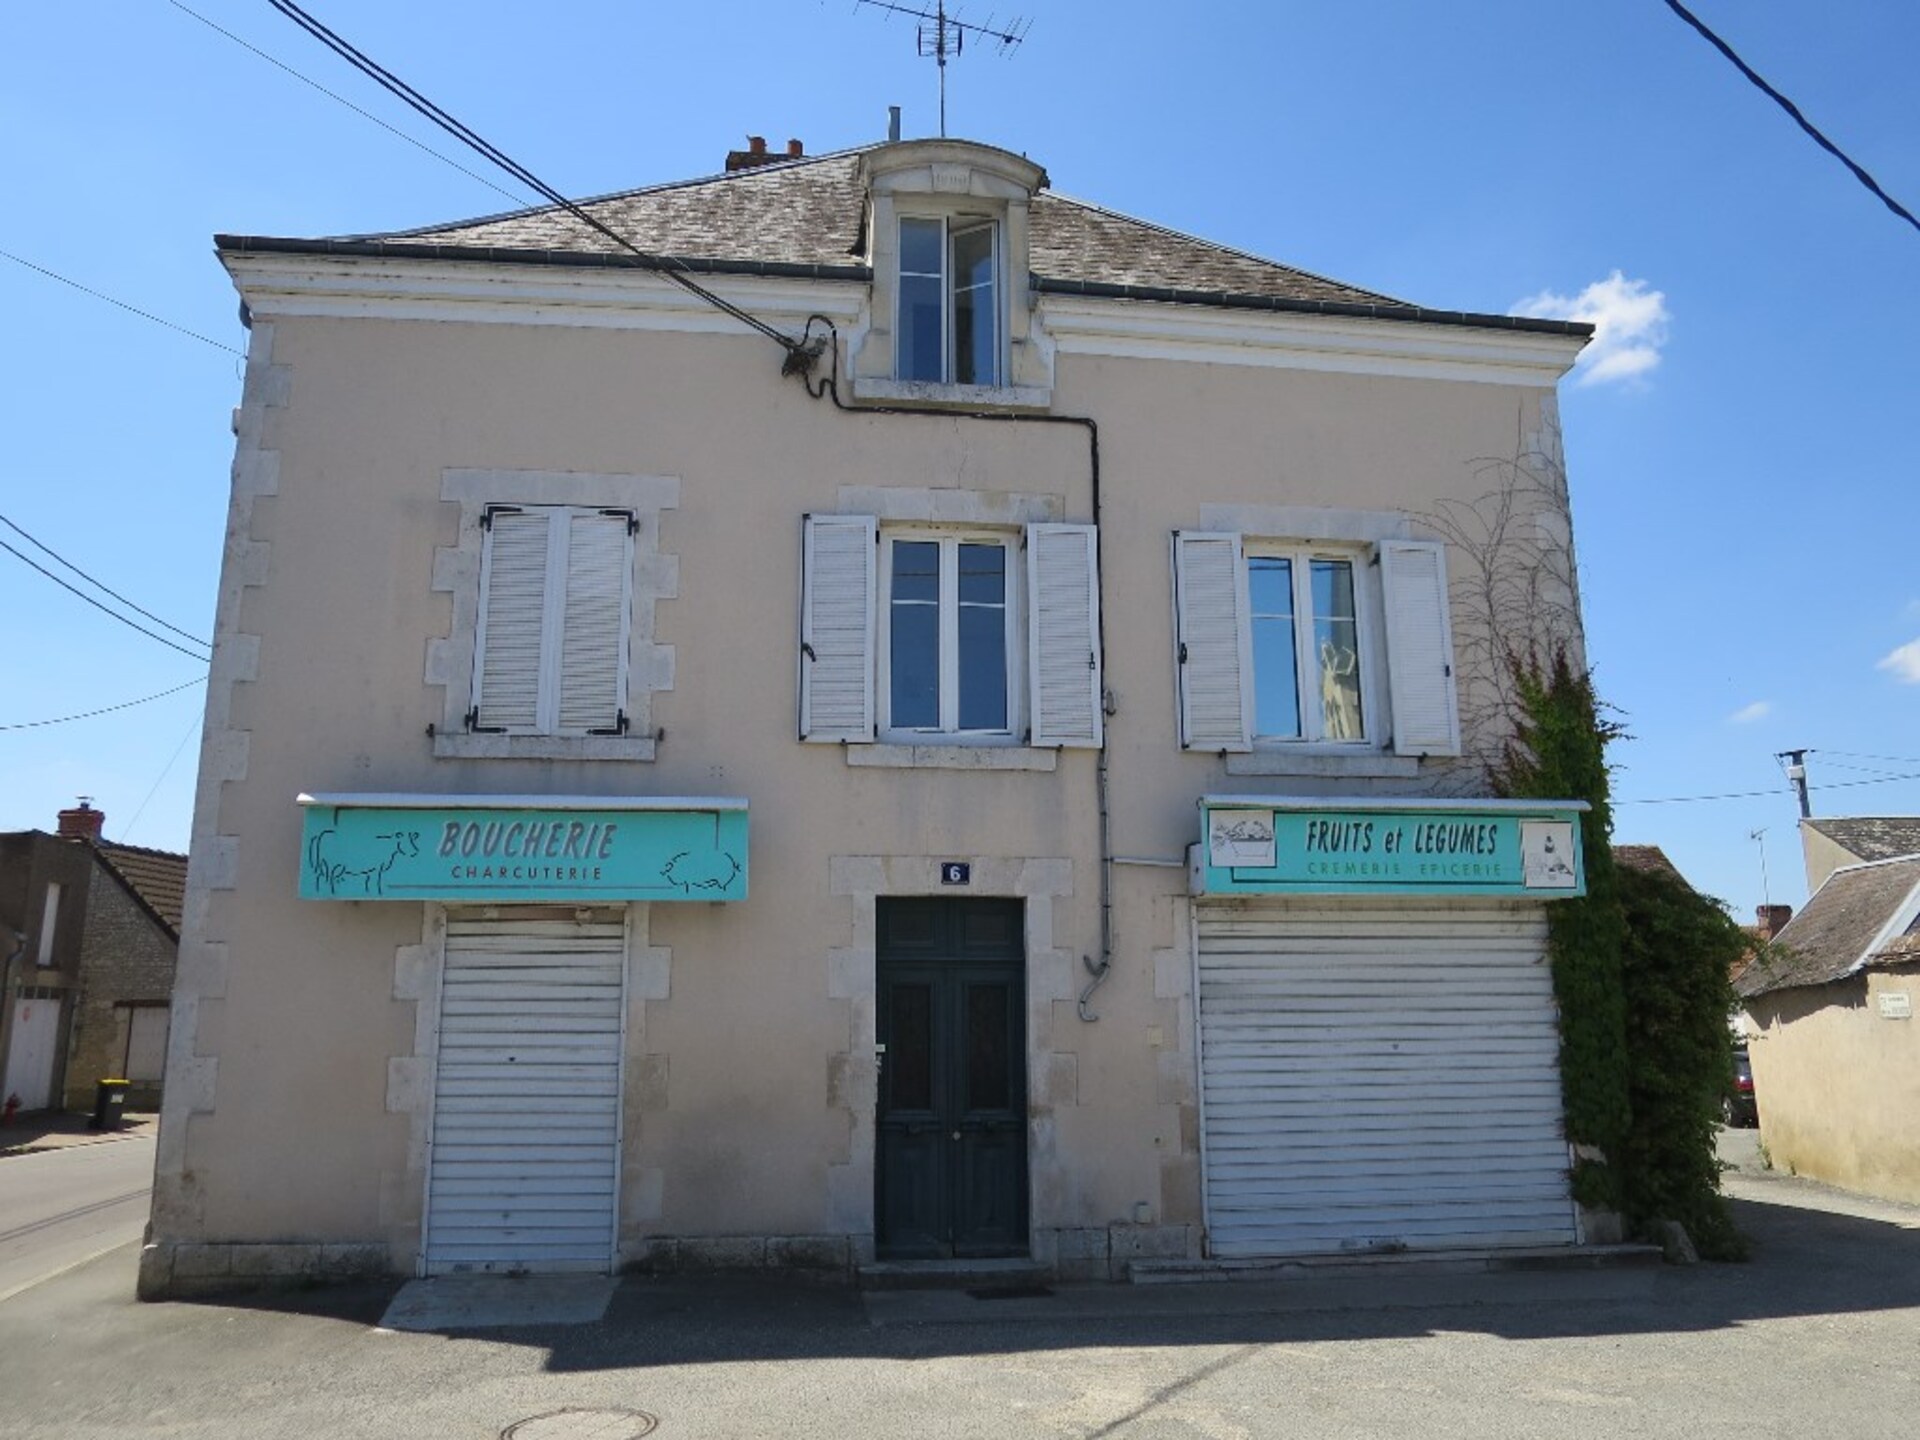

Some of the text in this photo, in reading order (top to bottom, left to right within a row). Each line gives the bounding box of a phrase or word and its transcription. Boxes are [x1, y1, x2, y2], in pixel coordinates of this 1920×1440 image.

[438, 821, 617, 859] BOUCHERIE
[1306, 820, 1498, 854] FRUITS et LEGUMES
[451, 865, 601, 880] CHARCUTERIE
[950, 865, 961, 881] 6
[1308, 862, 1501, 876] CREMERIE EPICERIE
